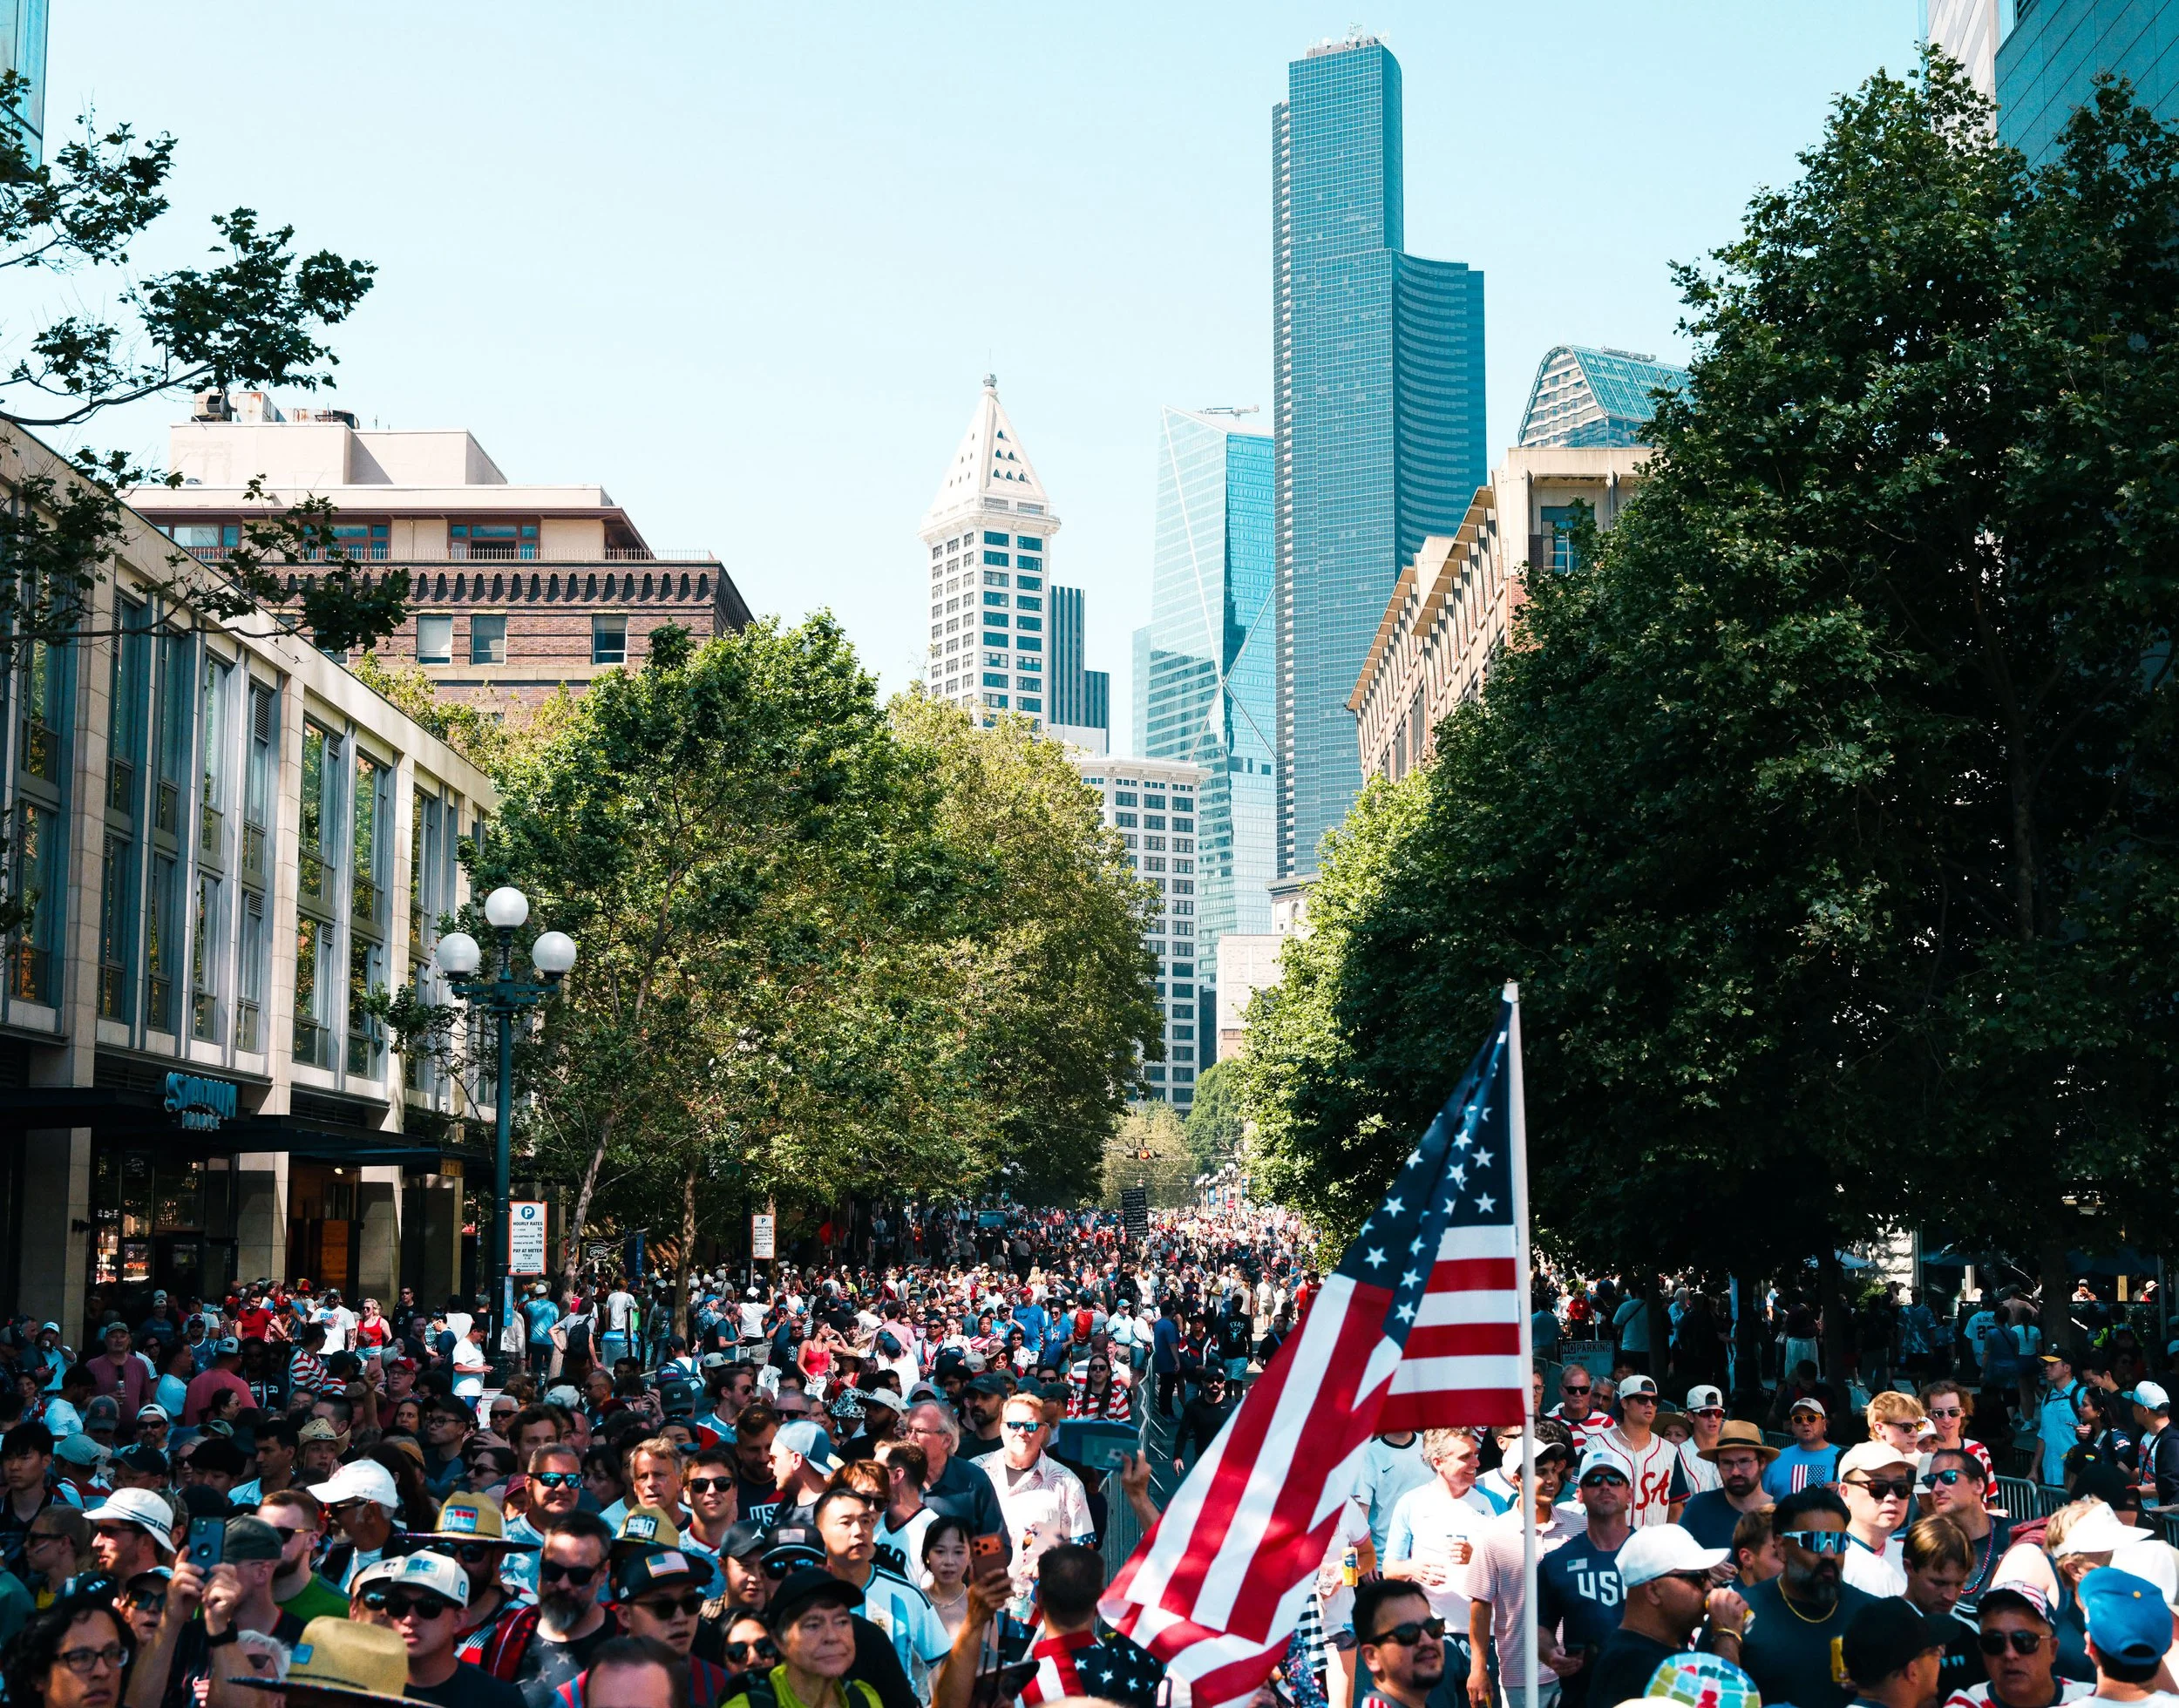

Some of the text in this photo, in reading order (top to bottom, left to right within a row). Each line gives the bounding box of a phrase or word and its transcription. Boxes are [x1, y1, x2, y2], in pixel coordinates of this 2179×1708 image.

[164, 1072, 237, 1120] STADIUM
[525, 1208, 533, 1218] P
[1563, 1342, 1612, 1353] NO PARKING
[1636, 1469, 1670, 1509] SA
